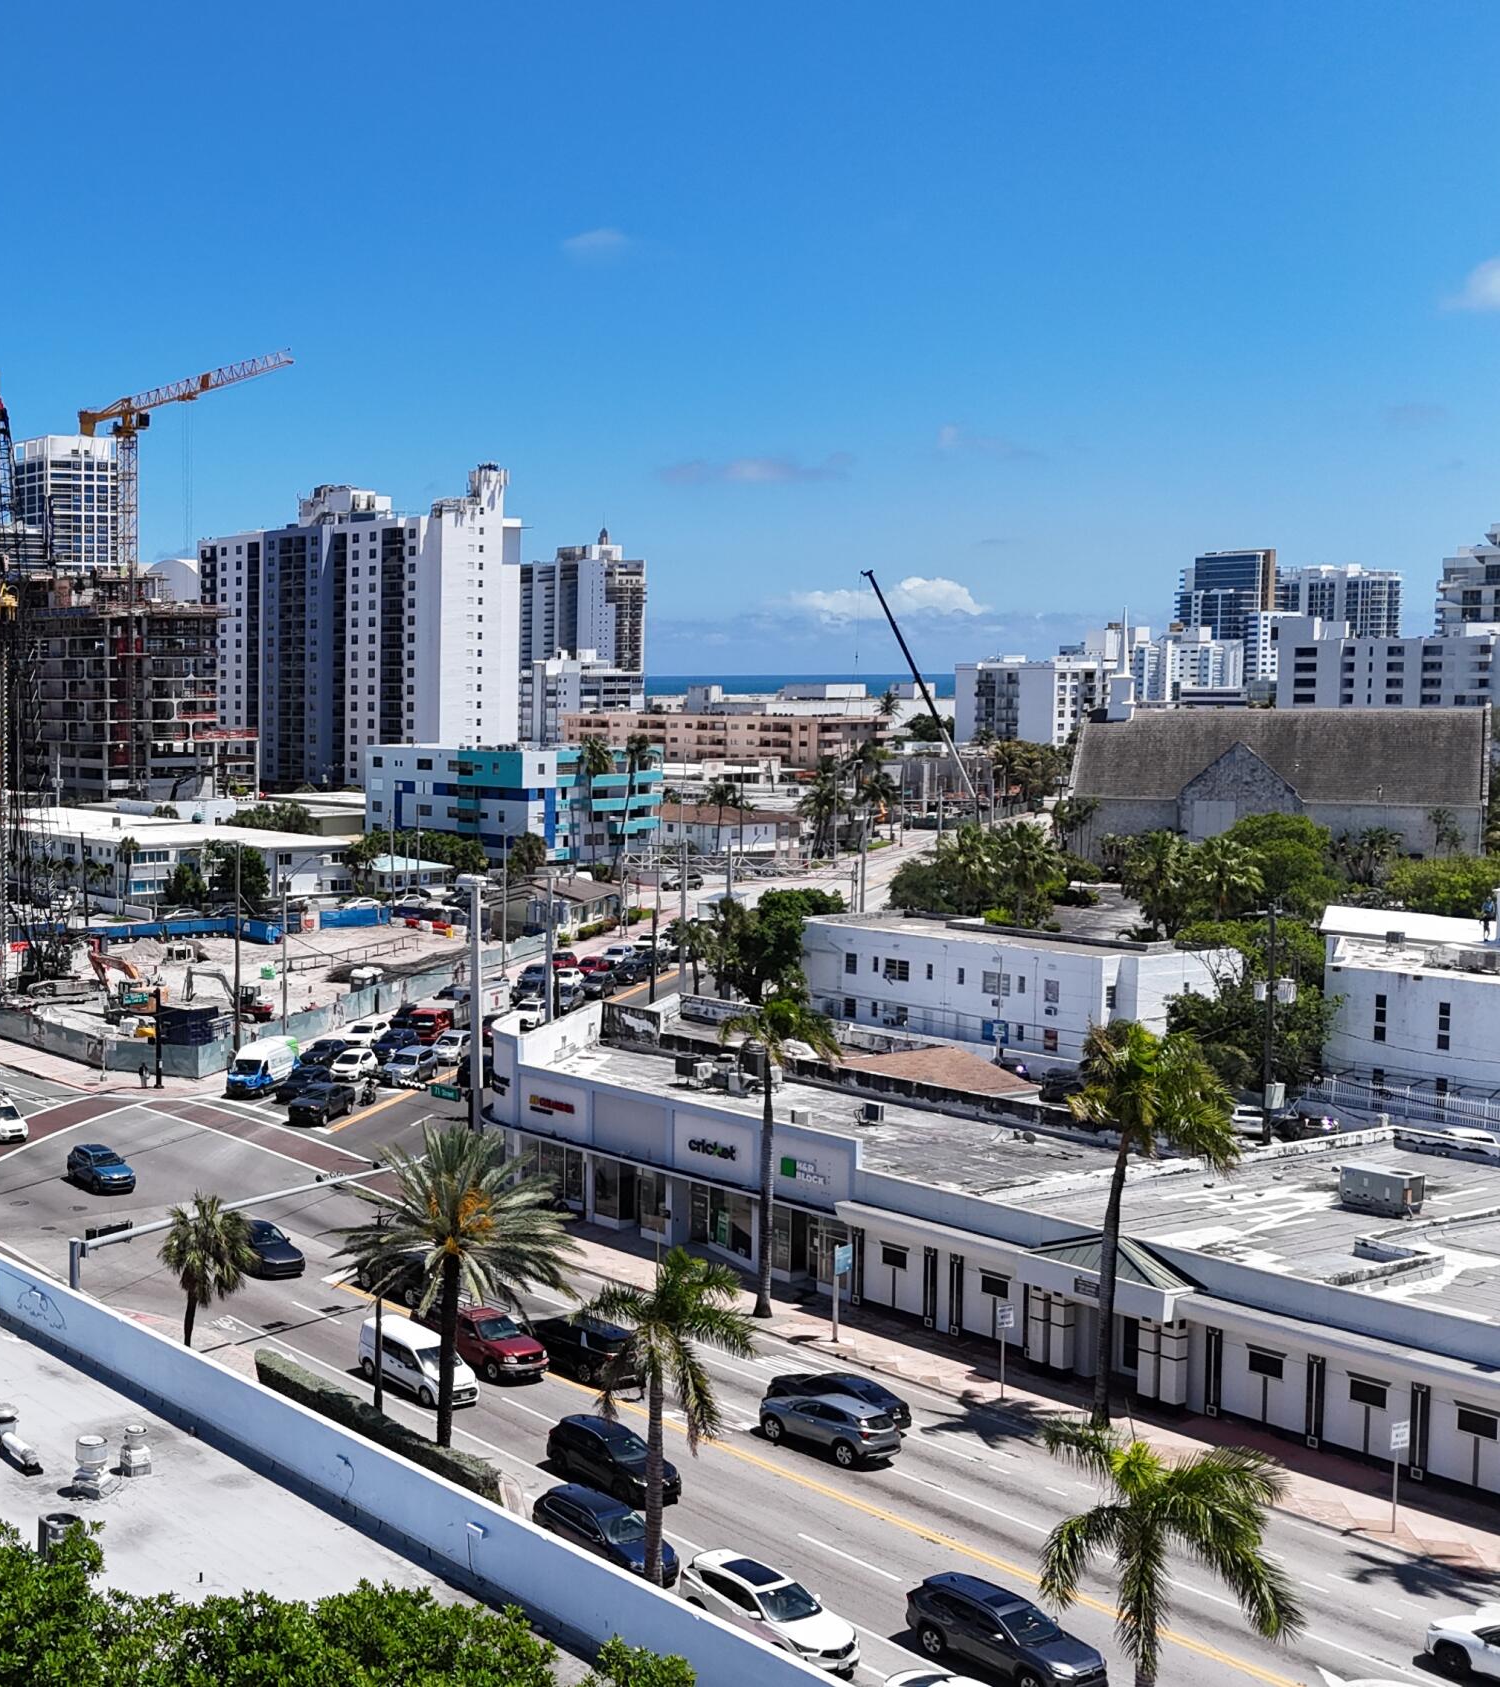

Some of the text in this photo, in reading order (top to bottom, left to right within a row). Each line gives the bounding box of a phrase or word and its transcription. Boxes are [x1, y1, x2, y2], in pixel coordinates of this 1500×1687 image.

[433, 1086, 455, 1099] 71 Street
[688, 1138, 736, 1161] cricket
[796, 1160, 816, 1173] H&R
[796, 1172, 825, 1185] BLOCK
